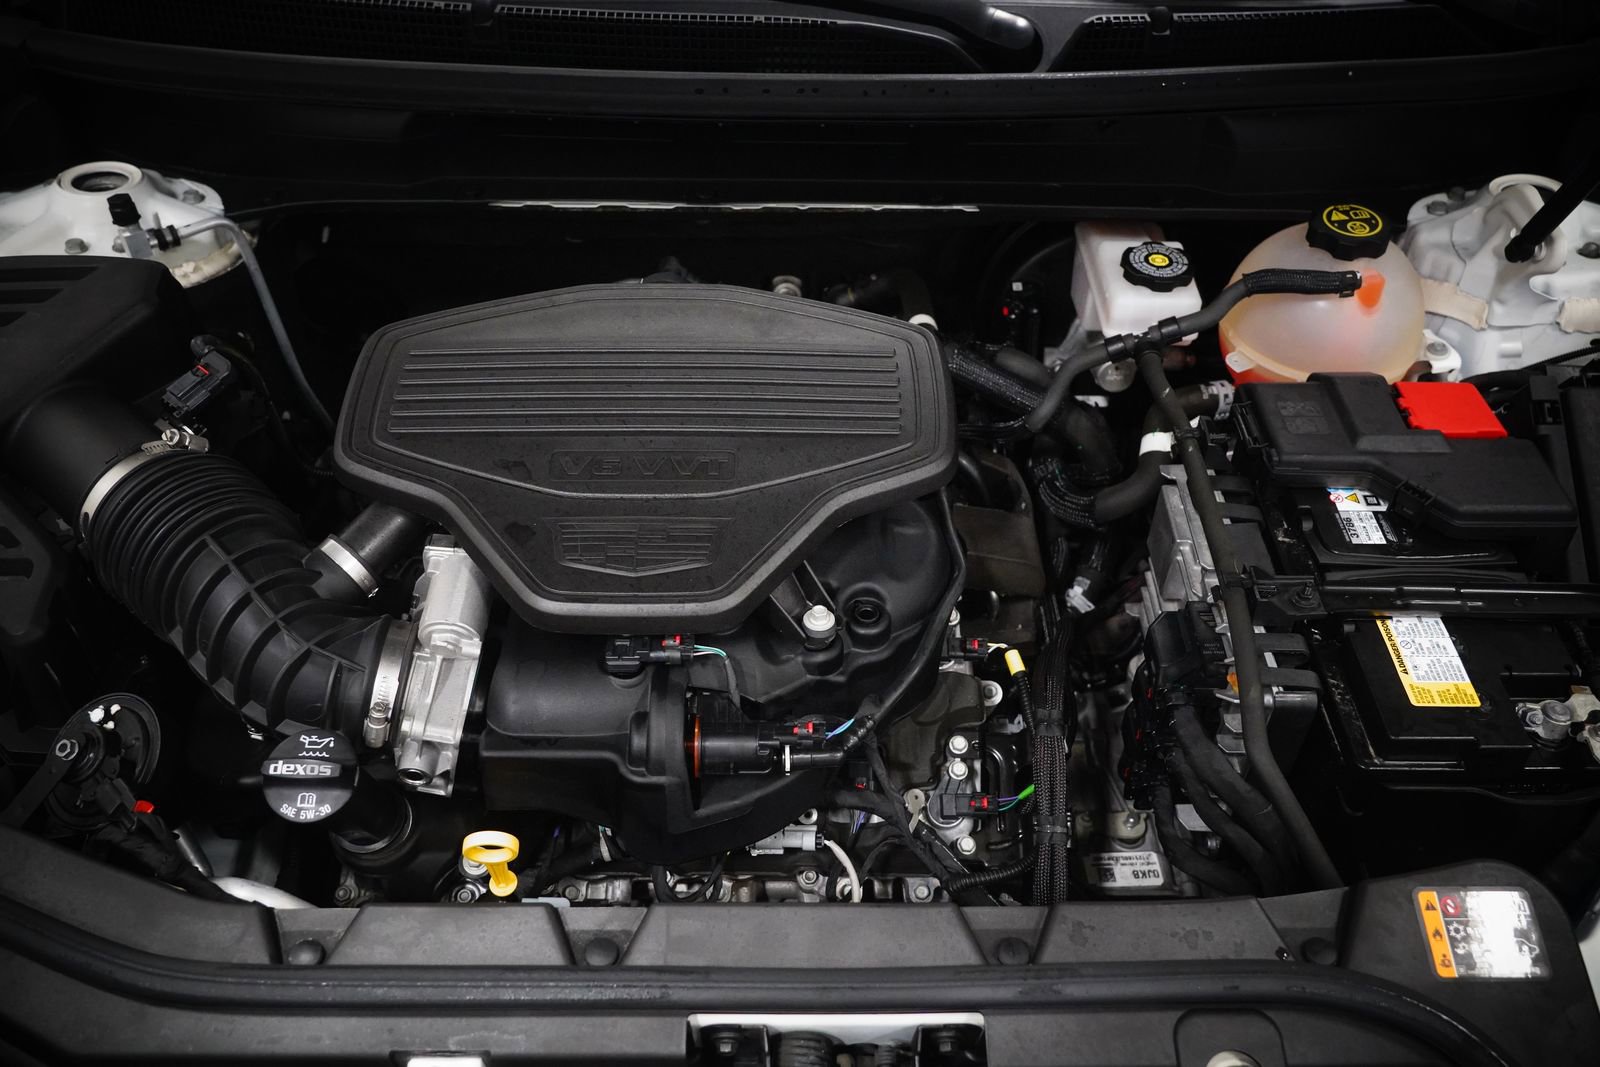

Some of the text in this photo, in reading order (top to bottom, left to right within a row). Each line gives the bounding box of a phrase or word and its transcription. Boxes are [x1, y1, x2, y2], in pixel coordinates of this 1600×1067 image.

[632, 456, 729, 475] VVT
[1343, 517, 1359, 538] 3786
[269, 760, 333, 775] dexos
[280, 803, 331, 820] SAE 5W-30
